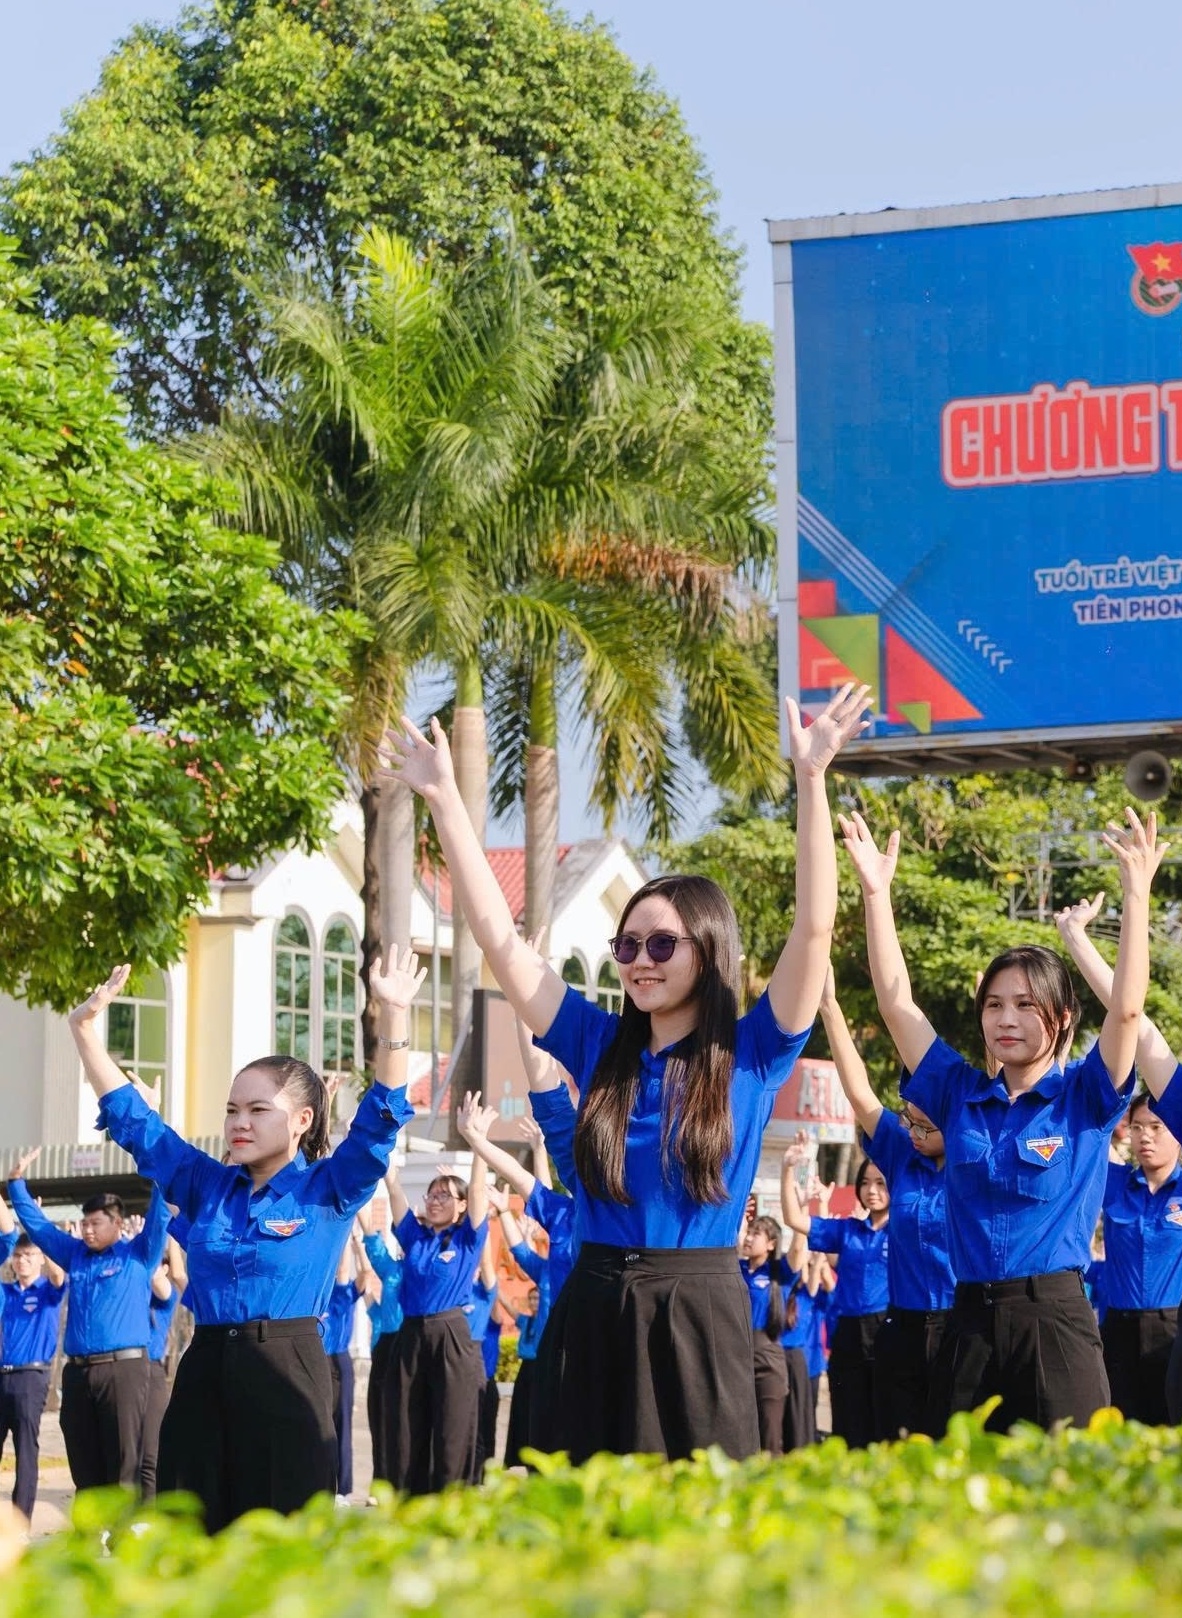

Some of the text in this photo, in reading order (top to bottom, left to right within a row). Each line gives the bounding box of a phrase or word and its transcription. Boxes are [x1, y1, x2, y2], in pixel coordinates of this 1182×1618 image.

[949, 386, 1155, 481] CHƯƠNG
[1038, 561, 1086, 590] TUỔI
[1091, 559, 1130, 587] TRẺ
[1135, 558, 1182, 588] VIỆT
[1077, 598, 1122, 623] TIÊN
